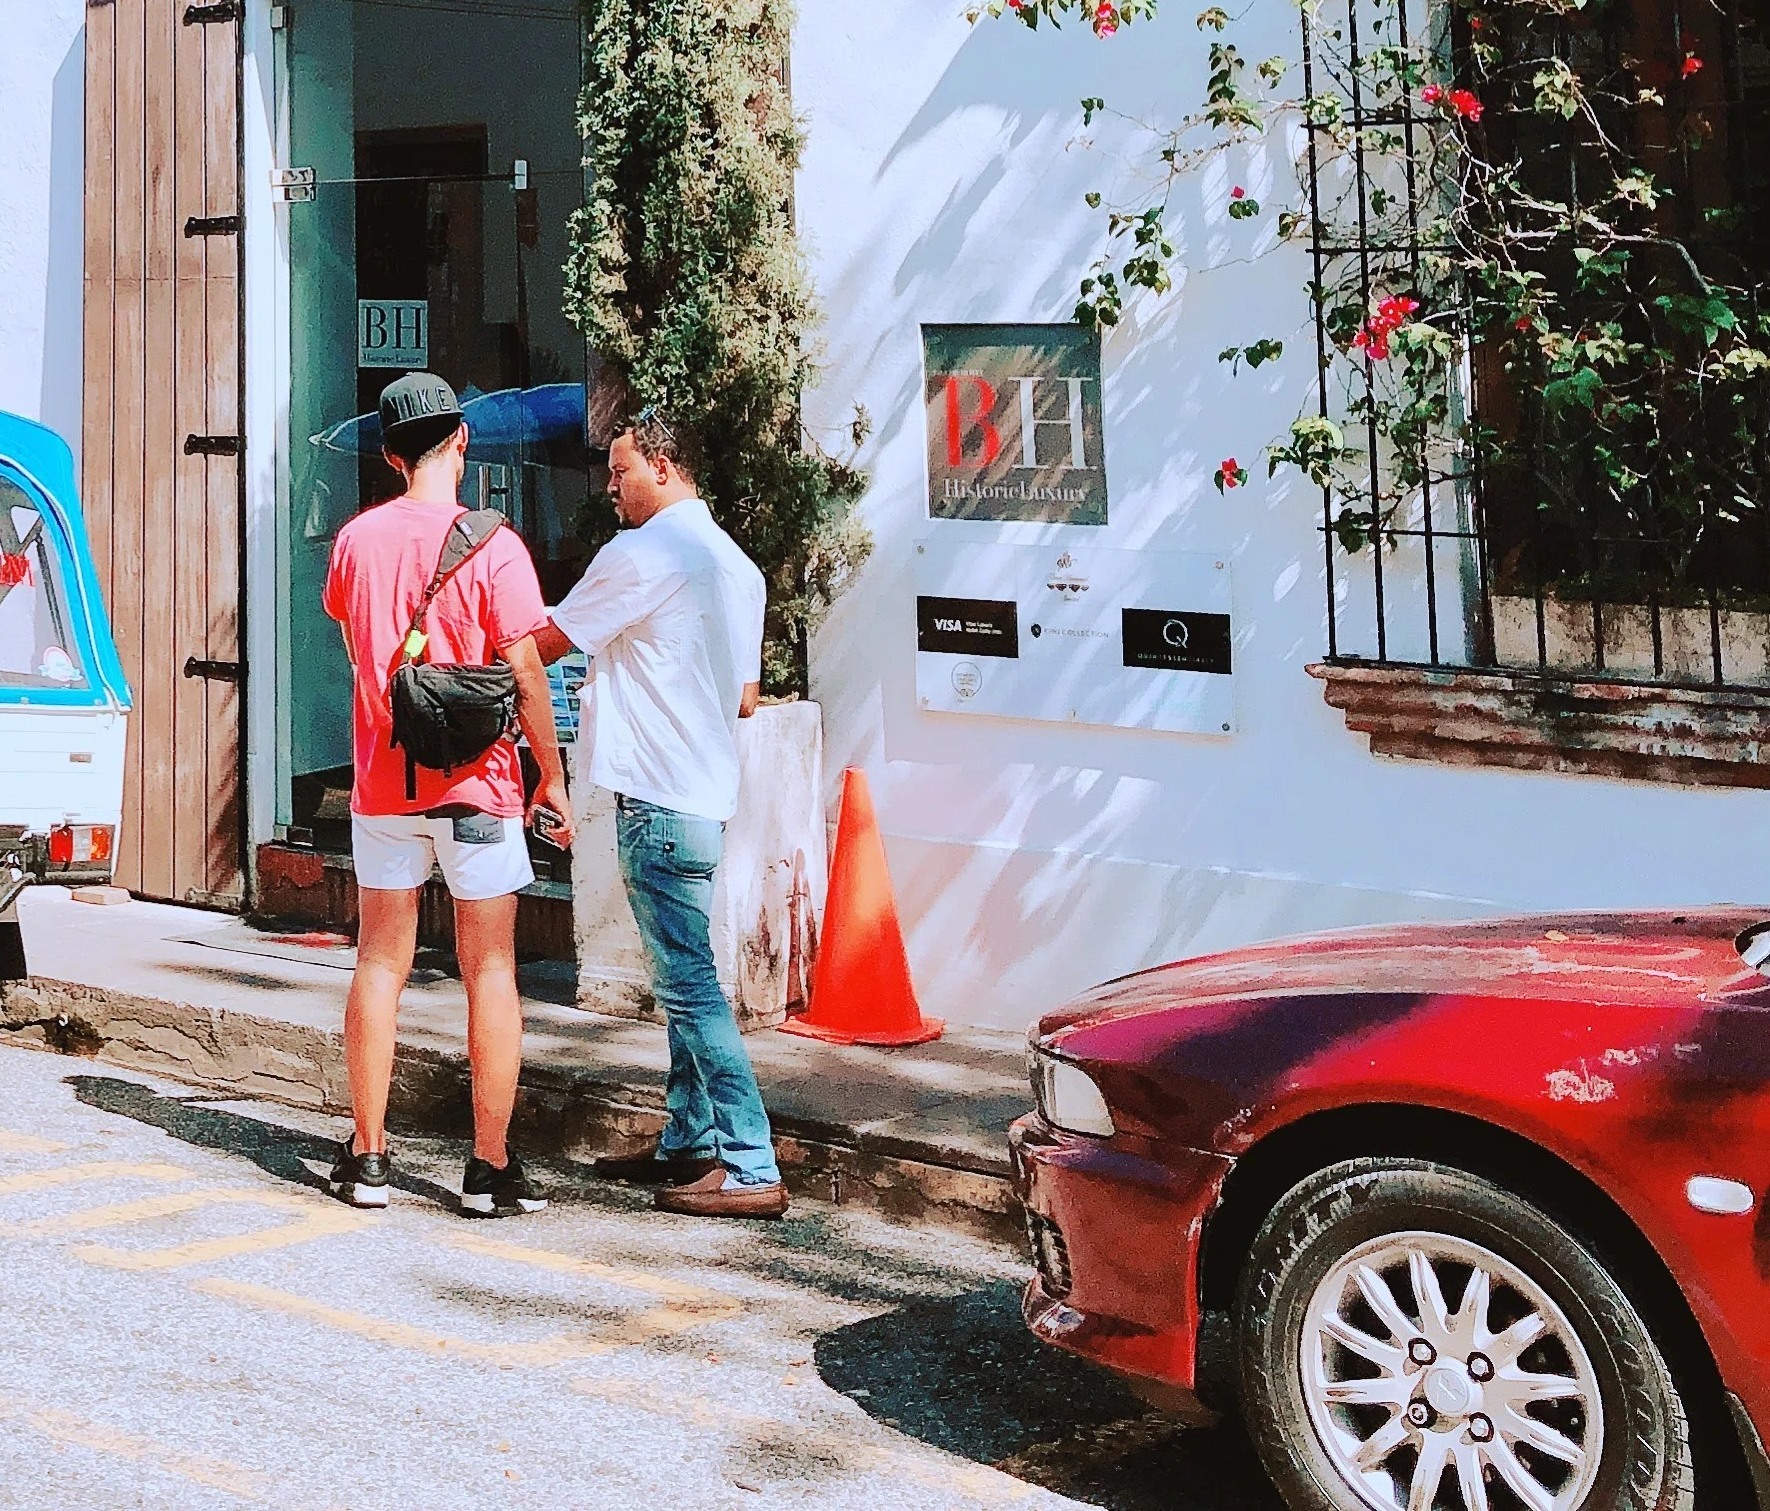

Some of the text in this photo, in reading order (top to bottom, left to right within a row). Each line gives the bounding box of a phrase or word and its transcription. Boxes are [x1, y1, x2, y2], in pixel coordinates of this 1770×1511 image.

[361, 306, 426, 350] BH
[385, 386, 452, 422] NIKE
[944, 375, 1098, 470] BH
[933, 619, 962, 631] VISA
[1163, 619, 1188, 649] Q
